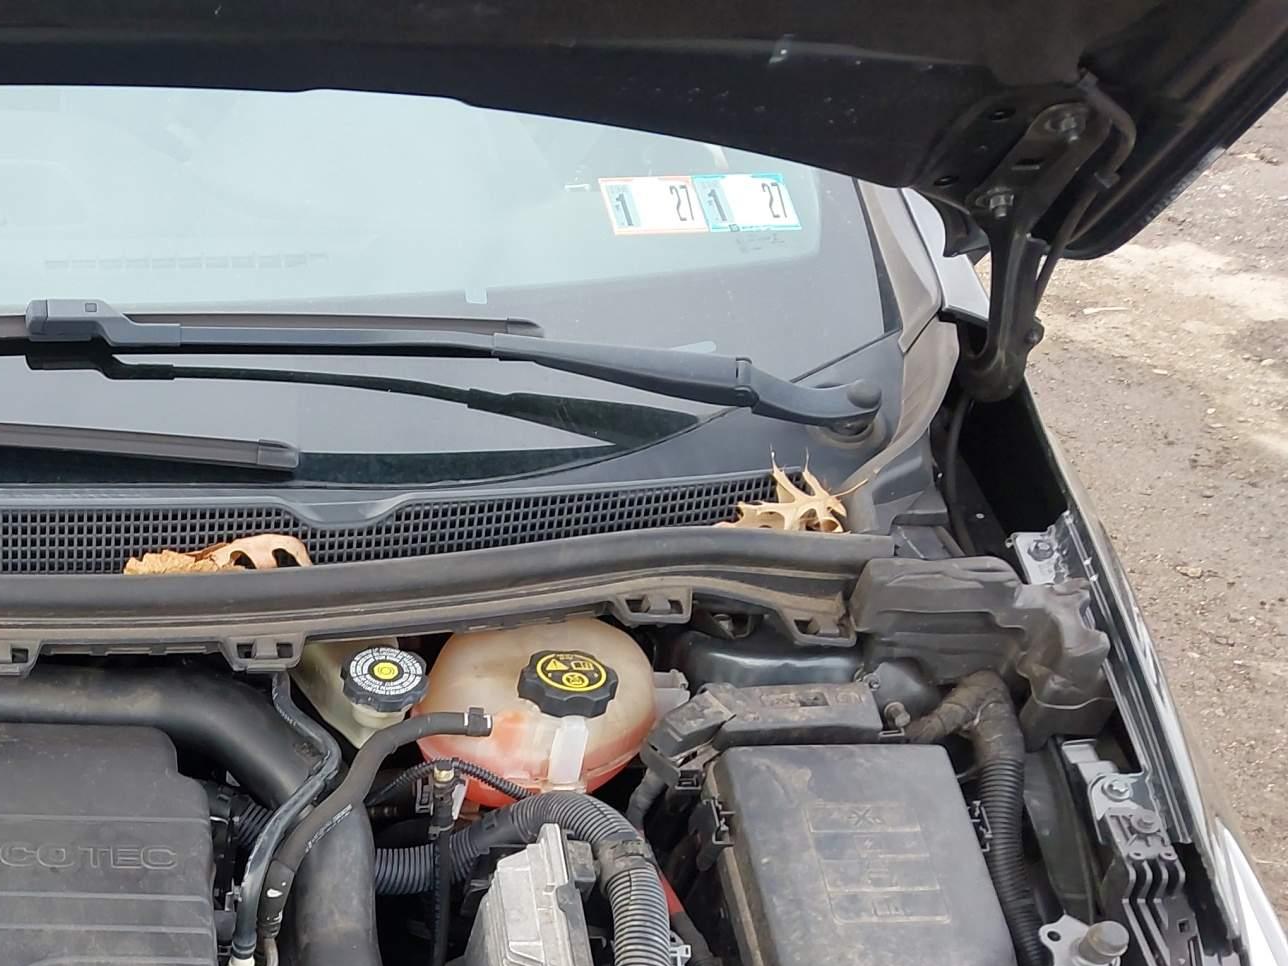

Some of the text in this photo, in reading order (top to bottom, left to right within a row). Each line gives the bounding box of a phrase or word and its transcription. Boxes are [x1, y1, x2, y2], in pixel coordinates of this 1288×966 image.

[615, 184, 695, 227] 1 27
[707, 181, 788, 222] 1 27
